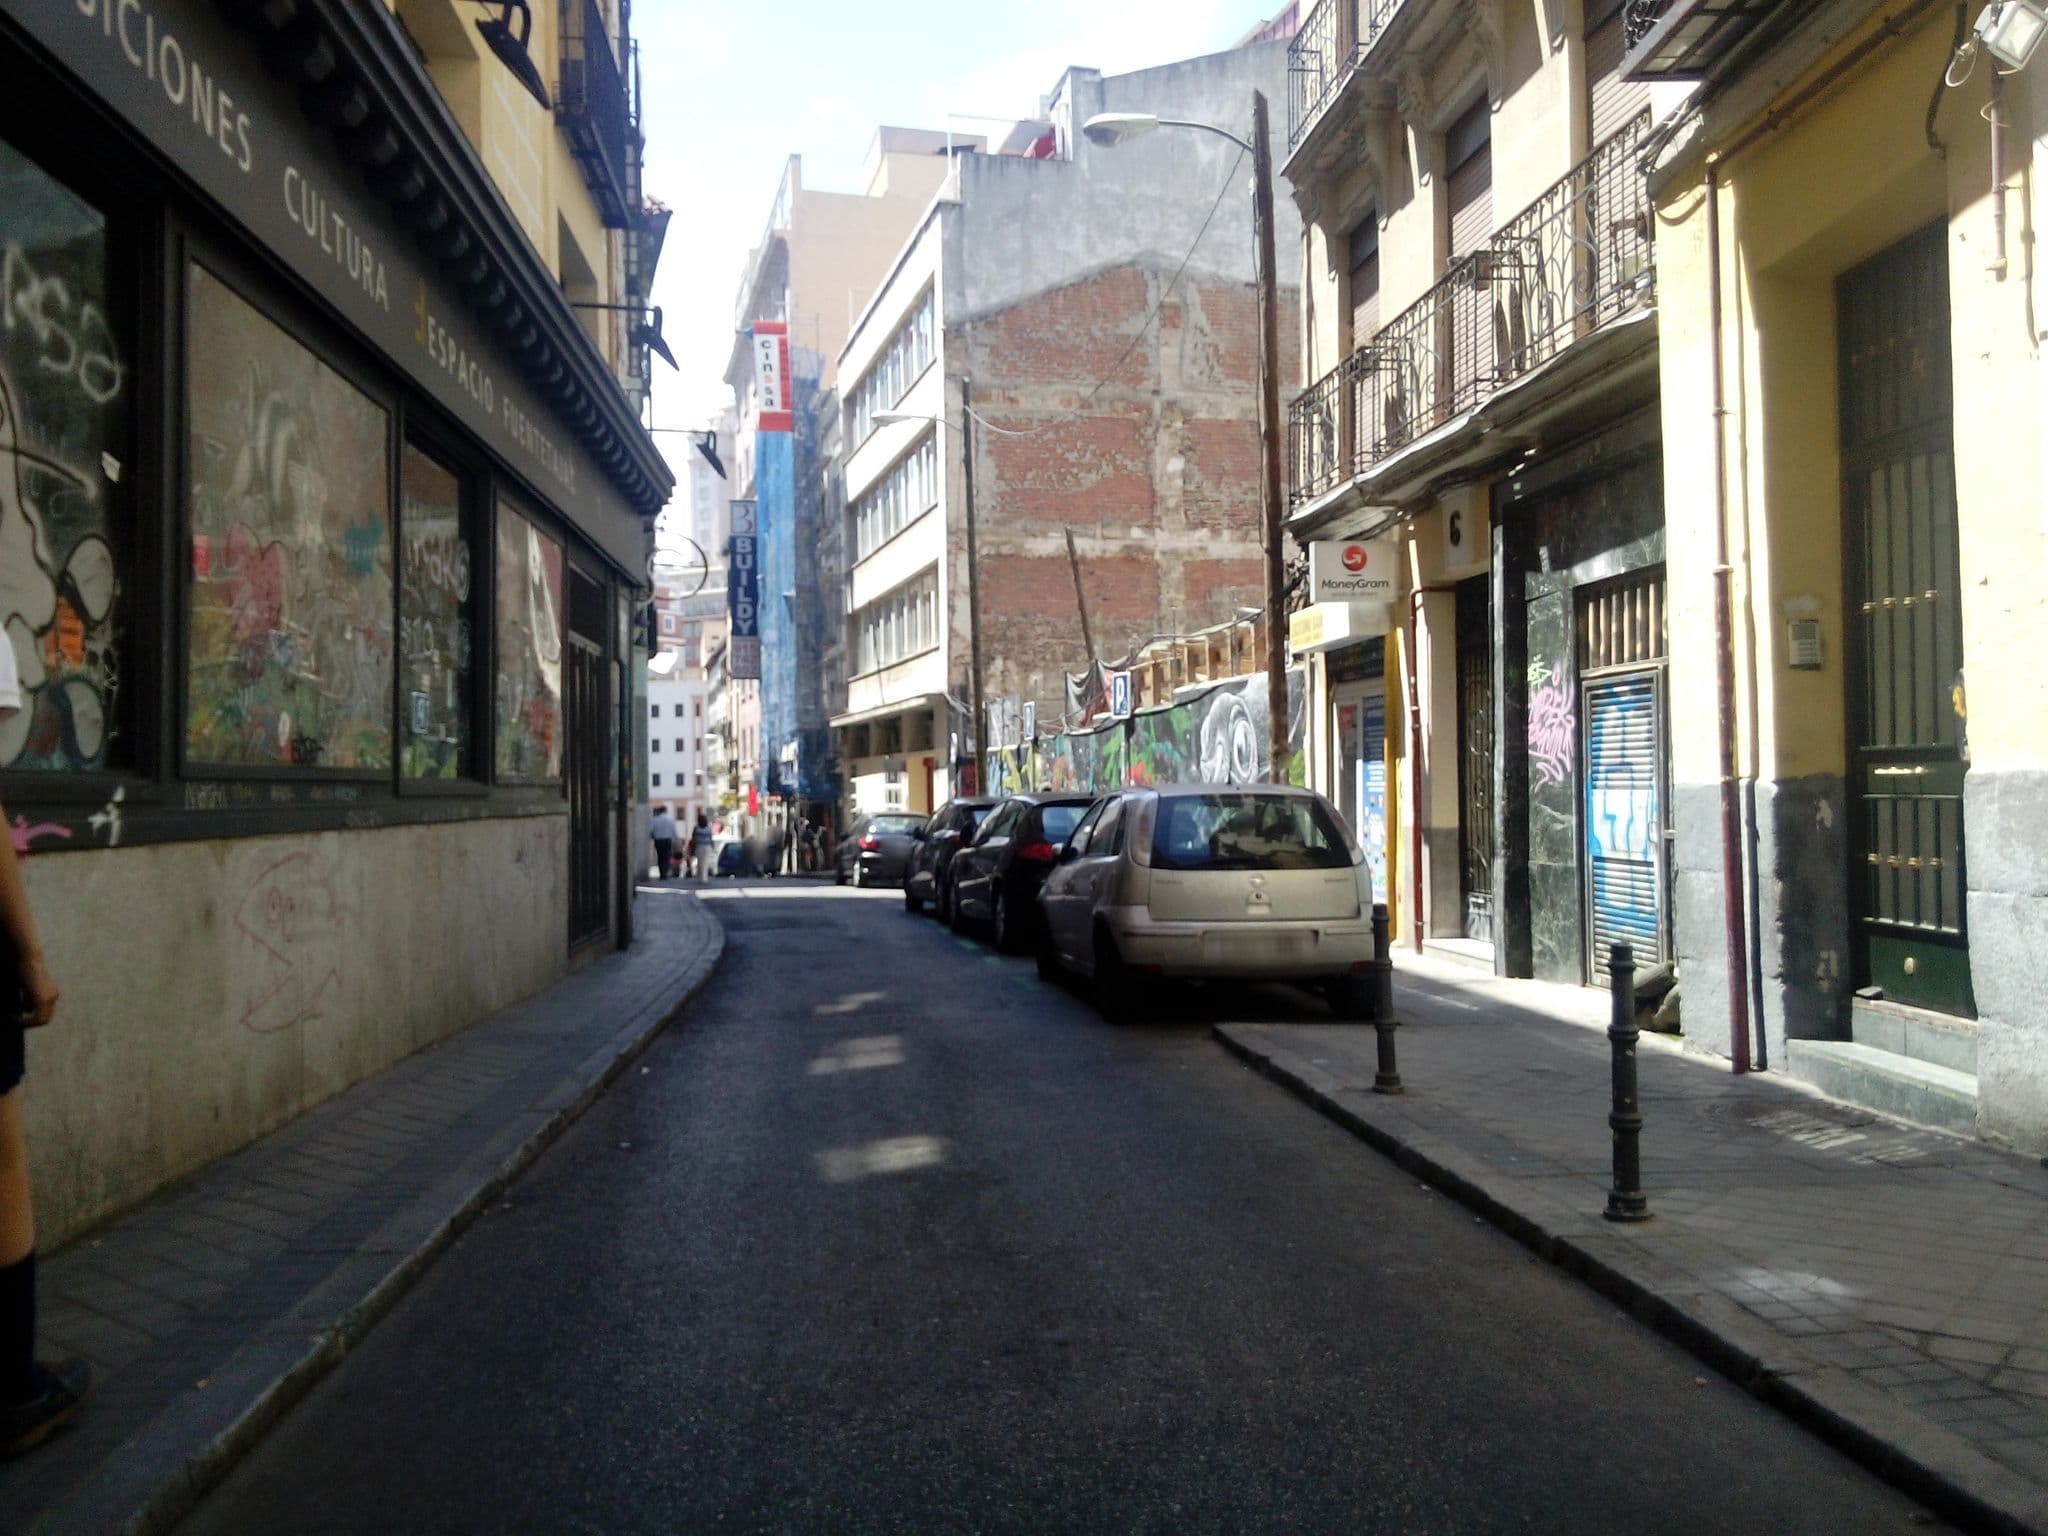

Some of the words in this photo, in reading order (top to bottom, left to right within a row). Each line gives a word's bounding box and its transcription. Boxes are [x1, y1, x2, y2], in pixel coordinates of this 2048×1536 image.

[76, 0, 251, 172] ICIONES
[284, 166, 389, 312] CULTURA
[427, 315, 494, 414] ESPACIO
[1449, 510, 1461, 547] 6
[735, 538, 753, 635] BUILDY
[1321, 578, 1389, 591] MoneyGram
